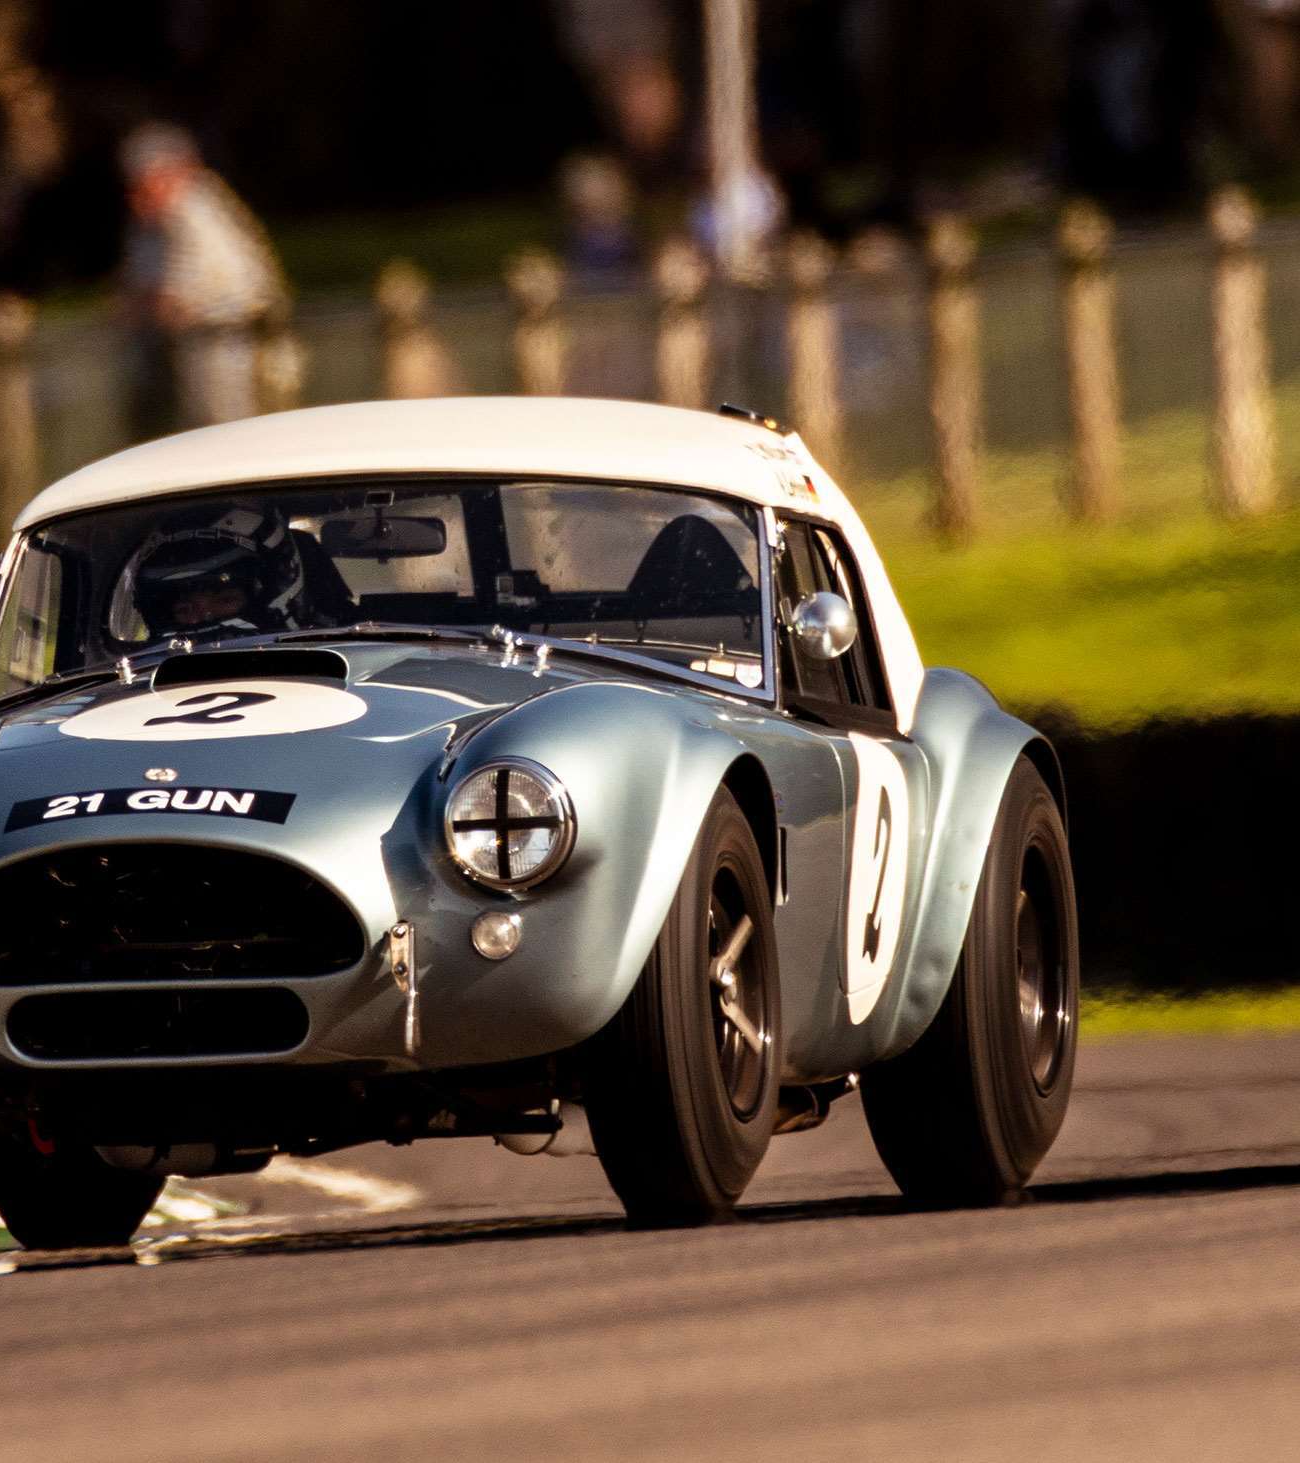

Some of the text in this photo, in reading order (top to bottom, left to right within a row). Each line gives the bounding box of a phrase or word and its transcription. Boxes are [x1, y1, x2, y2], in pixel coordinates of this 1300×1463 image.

[143, 691, 276, 726] 2
[42, 790, 255, 820] 21 GUN
[862, 785, 892, 964] 2
